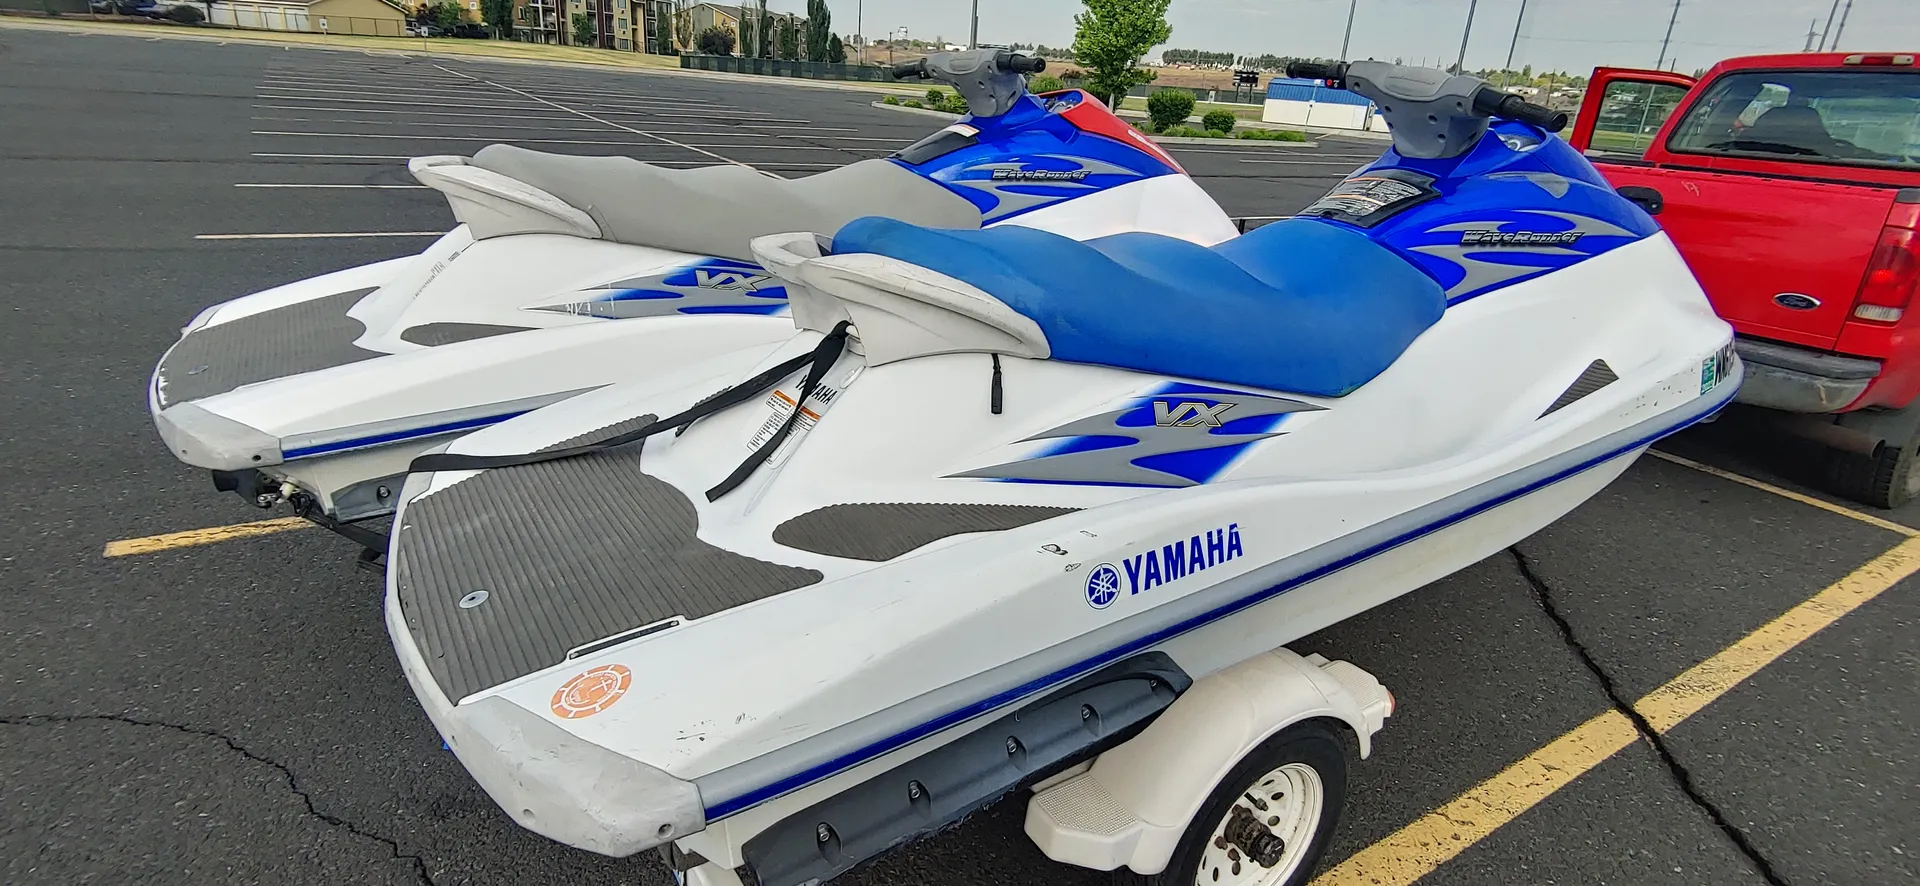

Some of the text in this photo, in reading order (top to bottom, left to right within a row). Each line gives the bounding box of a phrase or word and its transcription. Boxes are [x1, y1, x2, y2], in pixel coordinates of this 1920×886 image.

[1460, 229, 1586, 245] WaveRunner
[695, 269, 774, 292] VX
[1153, 400, 1239, 428] VX
[1122, 522, 1244, 597] YAMAHA
